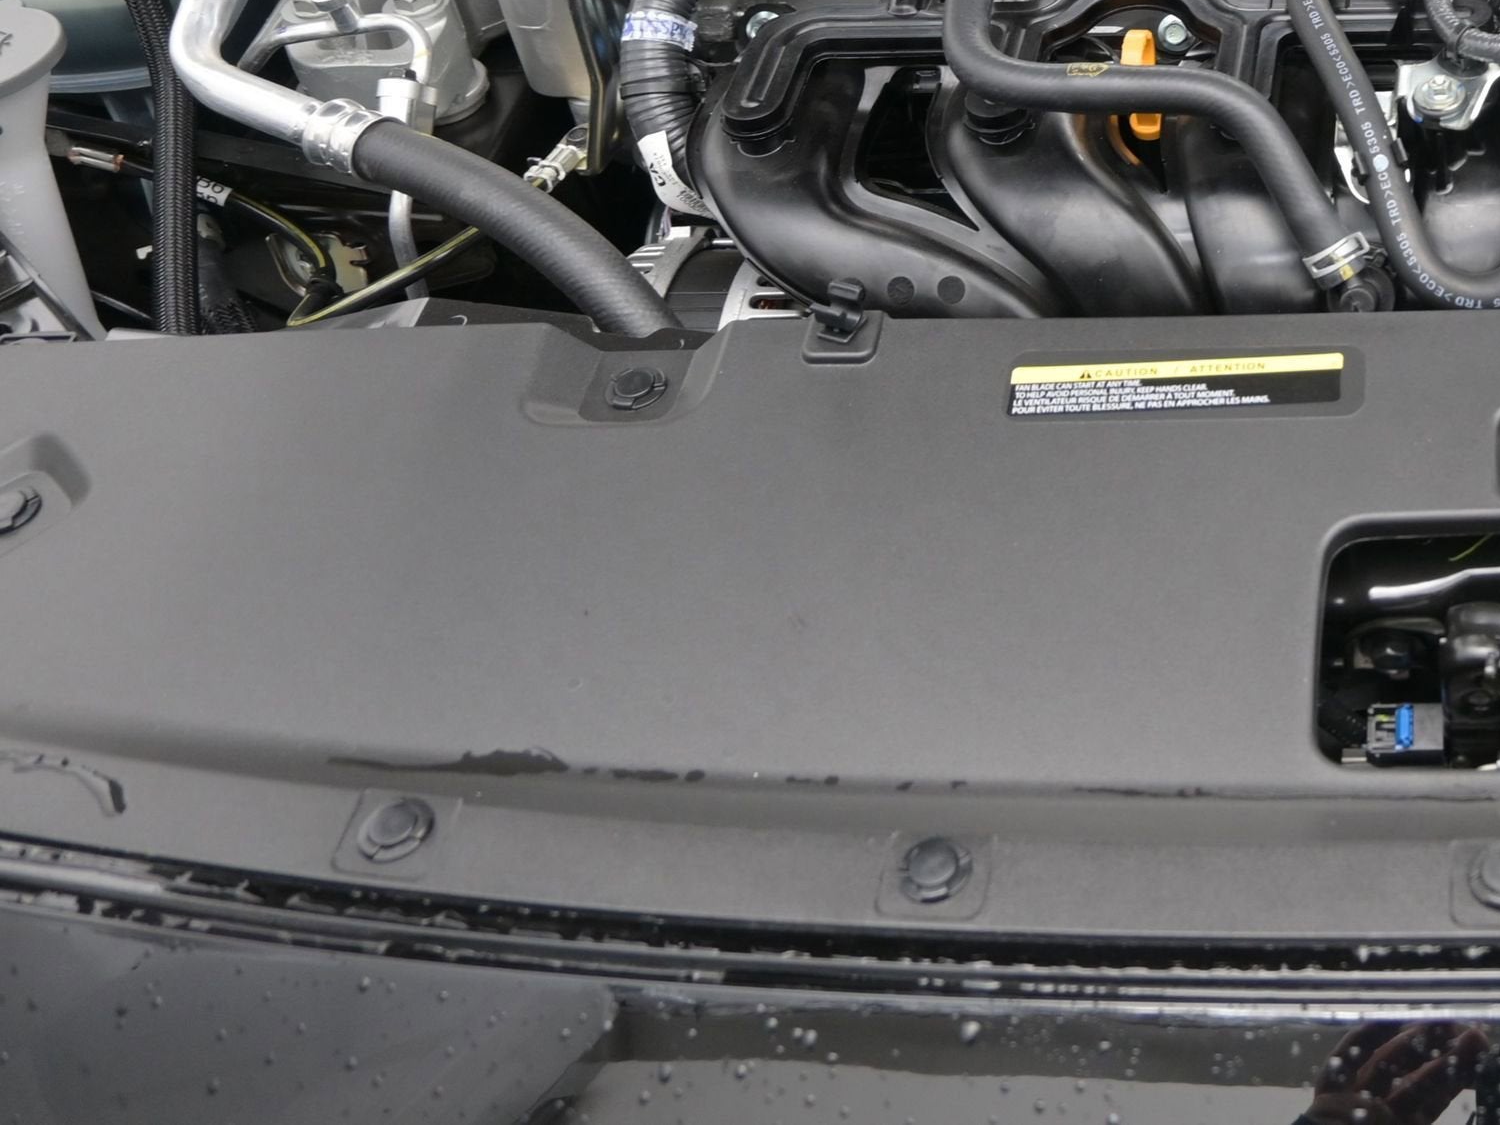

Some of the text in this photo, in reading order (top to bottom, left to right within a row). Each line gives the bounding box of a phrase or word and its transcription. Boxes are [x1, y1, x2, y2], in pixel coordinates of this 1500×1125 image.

[1320, 32, 1367, 115] TRD>ECO<5305
[1361, 121, 1402, 226] TRD>ECO5305
[1396, 232, 1483, 309] TRD>ECO<5305
[1094, 367, 1158, 377] CAUTION
[1189, 362, 1266, 373] ATTENTION
[1026, 391, 1045, 399] HELP
[1045, 390, 1070, 398] AVOID
[1070, 388, 1108, 397] PERSONAL
[1136, 386, 1154, 394] KEEP
[1155, 385, 1182, 393] HANDS
[1031, 383, 1054, 391] BLADE
[1056, 382, 1072, 390] CAN
[1073, 381, 1095, 389] START
[1106, 380, 1123, 388] ANY
[1023, 398, 1077, 406] VENTILATEUR
[1078, 396, 1106, 404] RISQUE
[1108, 395, 1120, 403] DE
[1173, 392, 1196, 400] TOUT
[1065, 404, 1091, 412] TOUTE
[1135, 401, 1146, 409] NE
[1147, 400, 1162, 408] PAS
[1163, 399, 1175, 407] EN
[1176, 397, 1225, 407] APPROCHER
[1226, 396, 1240, 405] LES
